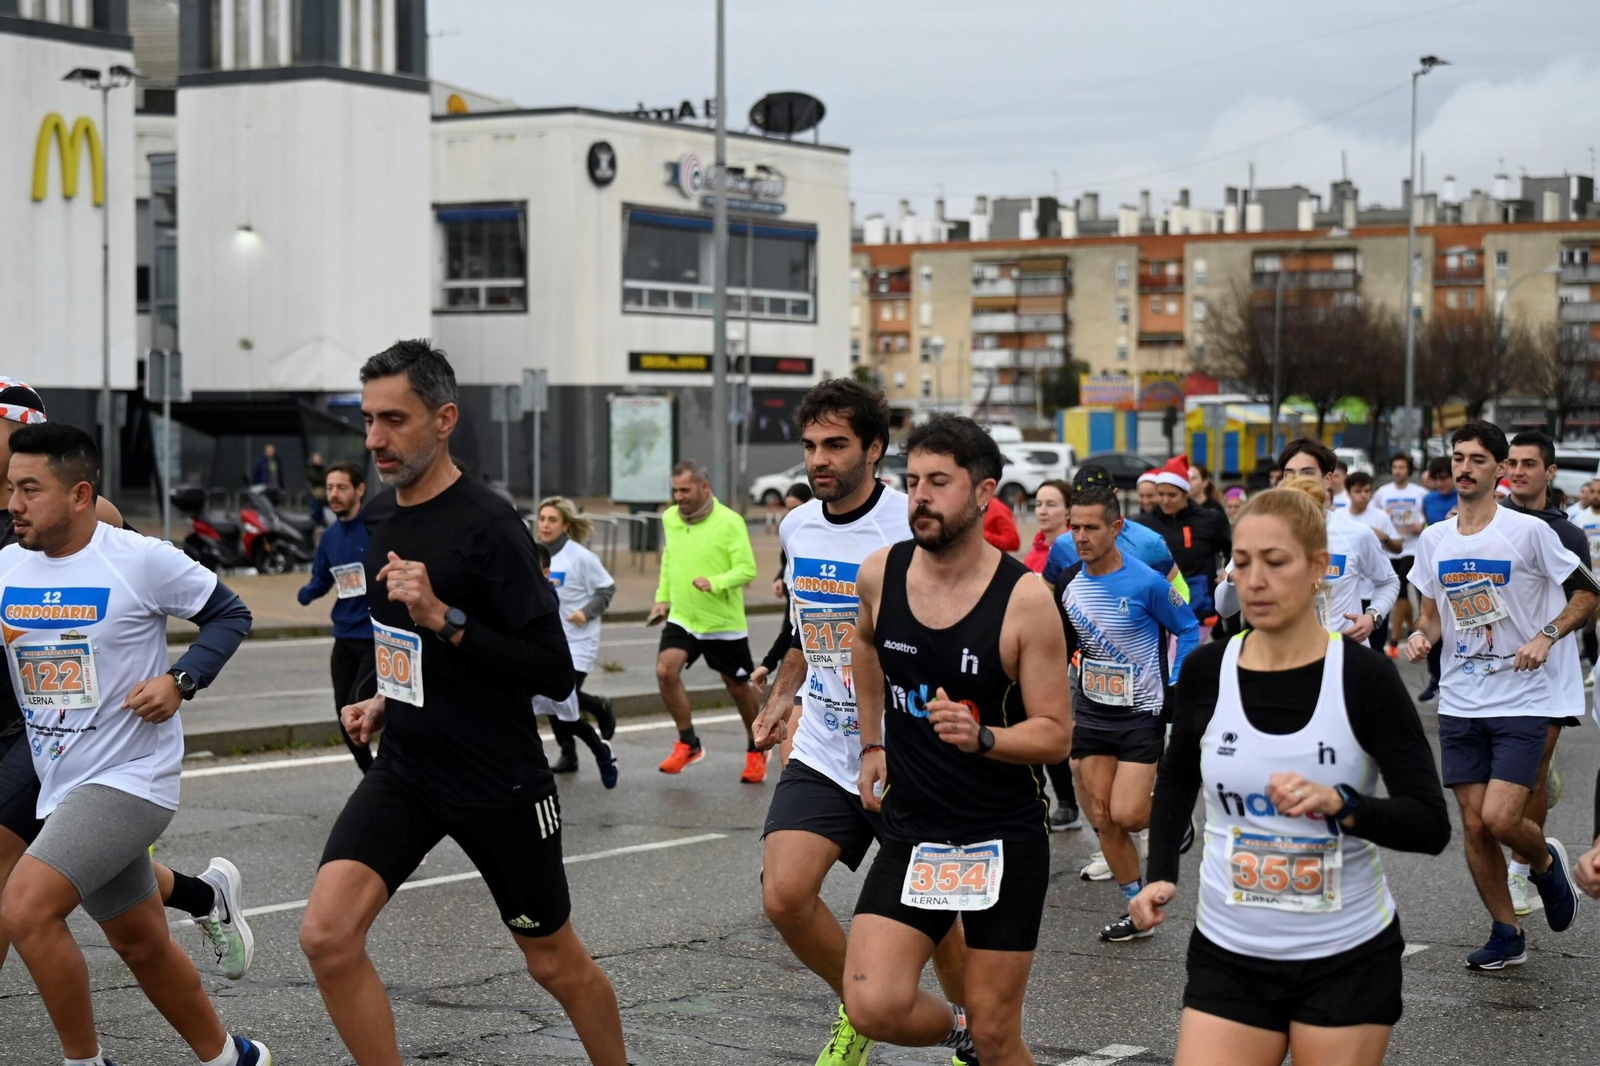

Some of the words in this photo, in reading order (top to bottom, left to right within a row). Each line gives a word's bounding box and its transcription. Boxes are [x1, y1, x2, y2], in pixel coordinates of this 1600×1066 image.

[820, 564, 837, 577] 12
[1462, 562, 1477, 571] 12
[42, 591, 62, 604] 12
[1450, 593, 1492, 619] 210
[5, 604, 98, 621] CORDOBARIA
[802, 622, 856, 651] 212
[961, 648, 979, 675] in
[21, 661, 83, 692] 122
[1084, 671, 1124, 695] 316
[1318, 742, 1336, 764] in
[910, 863, 987, 892] 354
[1231, 852, 1322, 893] 355
